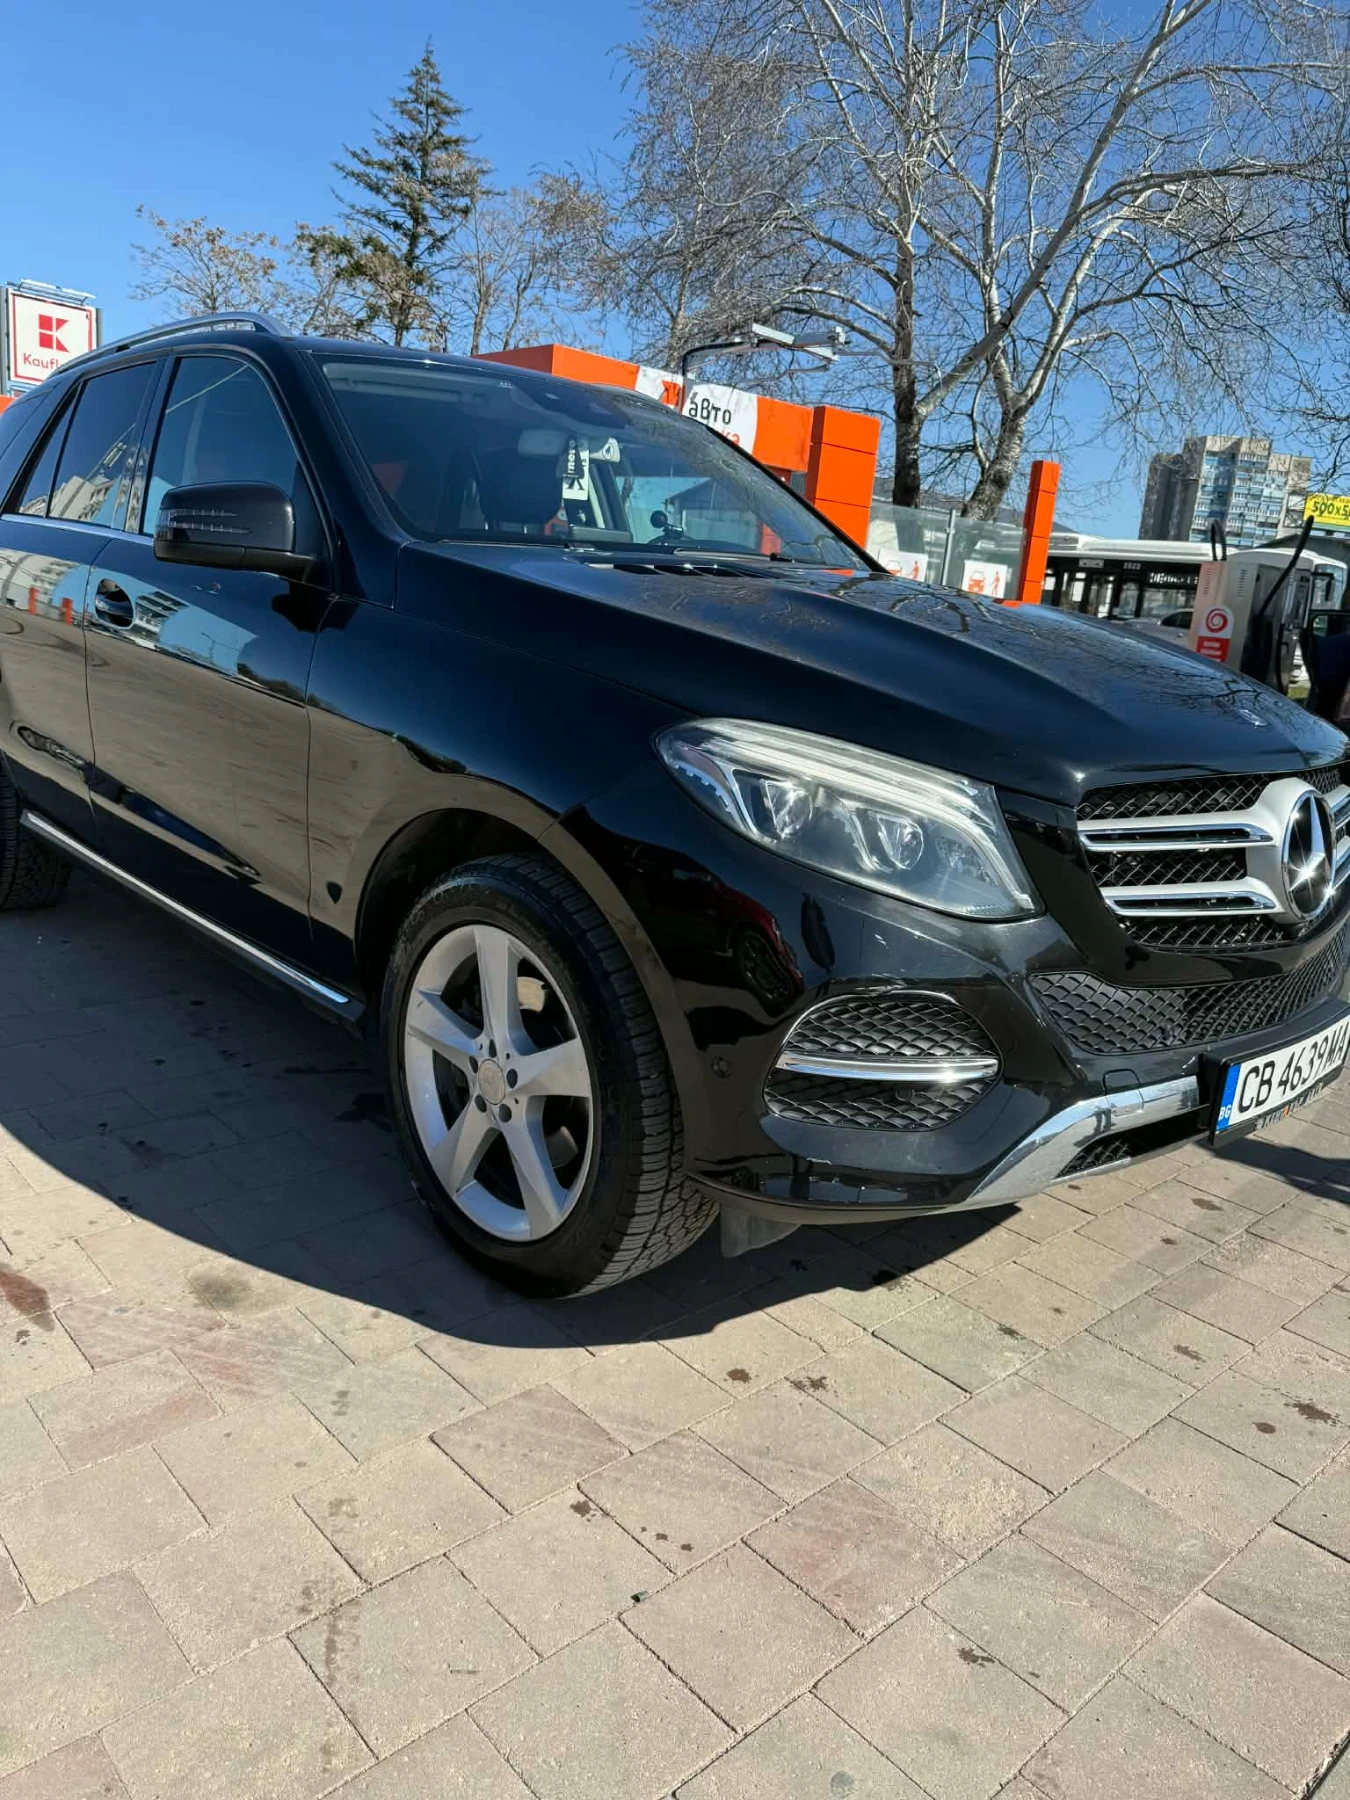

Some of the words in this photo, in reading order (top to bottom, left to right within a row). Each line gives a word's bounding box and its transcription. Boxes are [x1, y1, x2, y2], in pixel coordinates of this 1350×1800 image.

[1238, 1060, 1276, 1114] CB
[1278, 1035, 1329, 1096] 4639
[1218, 1105, 1233, 1120] BG
